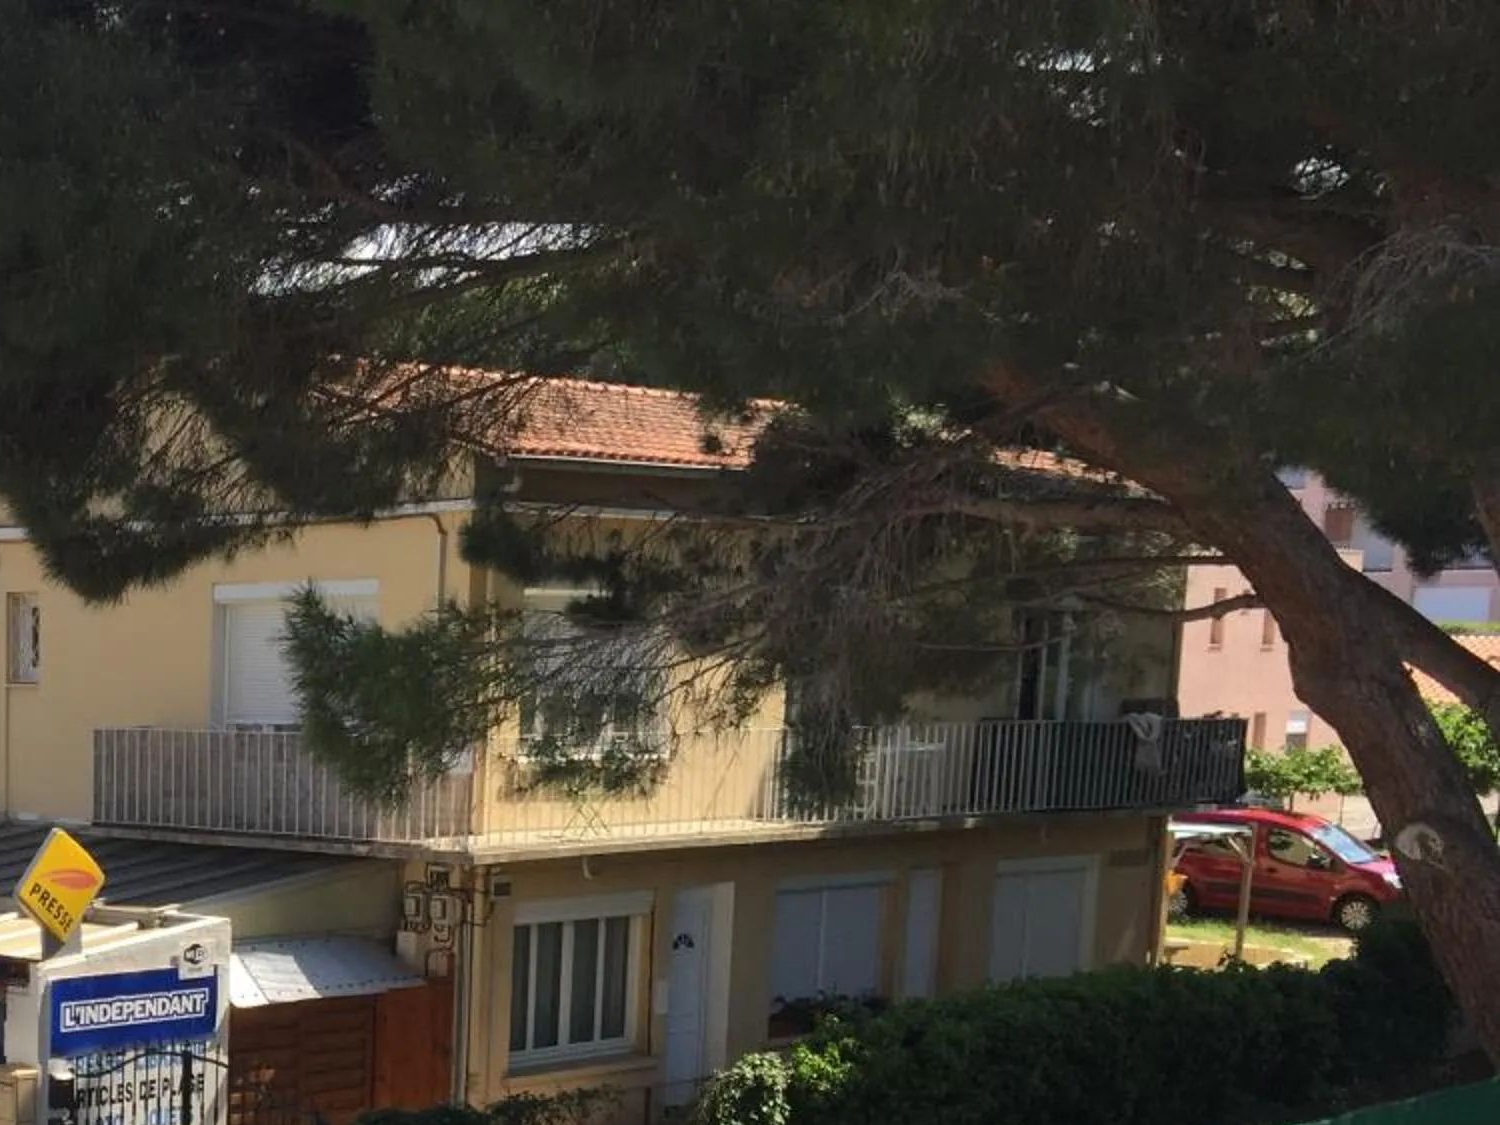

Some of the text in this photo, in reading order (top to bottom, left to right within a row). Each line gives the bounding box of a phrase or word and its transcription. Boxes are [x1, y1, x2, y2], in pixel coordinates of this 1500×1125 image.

[29, 883, 74, 934] PRESSE
[64, 993, 205, 1028] L'INDEPENDANT
[77, 1081, 133, 1108] RTICLES
